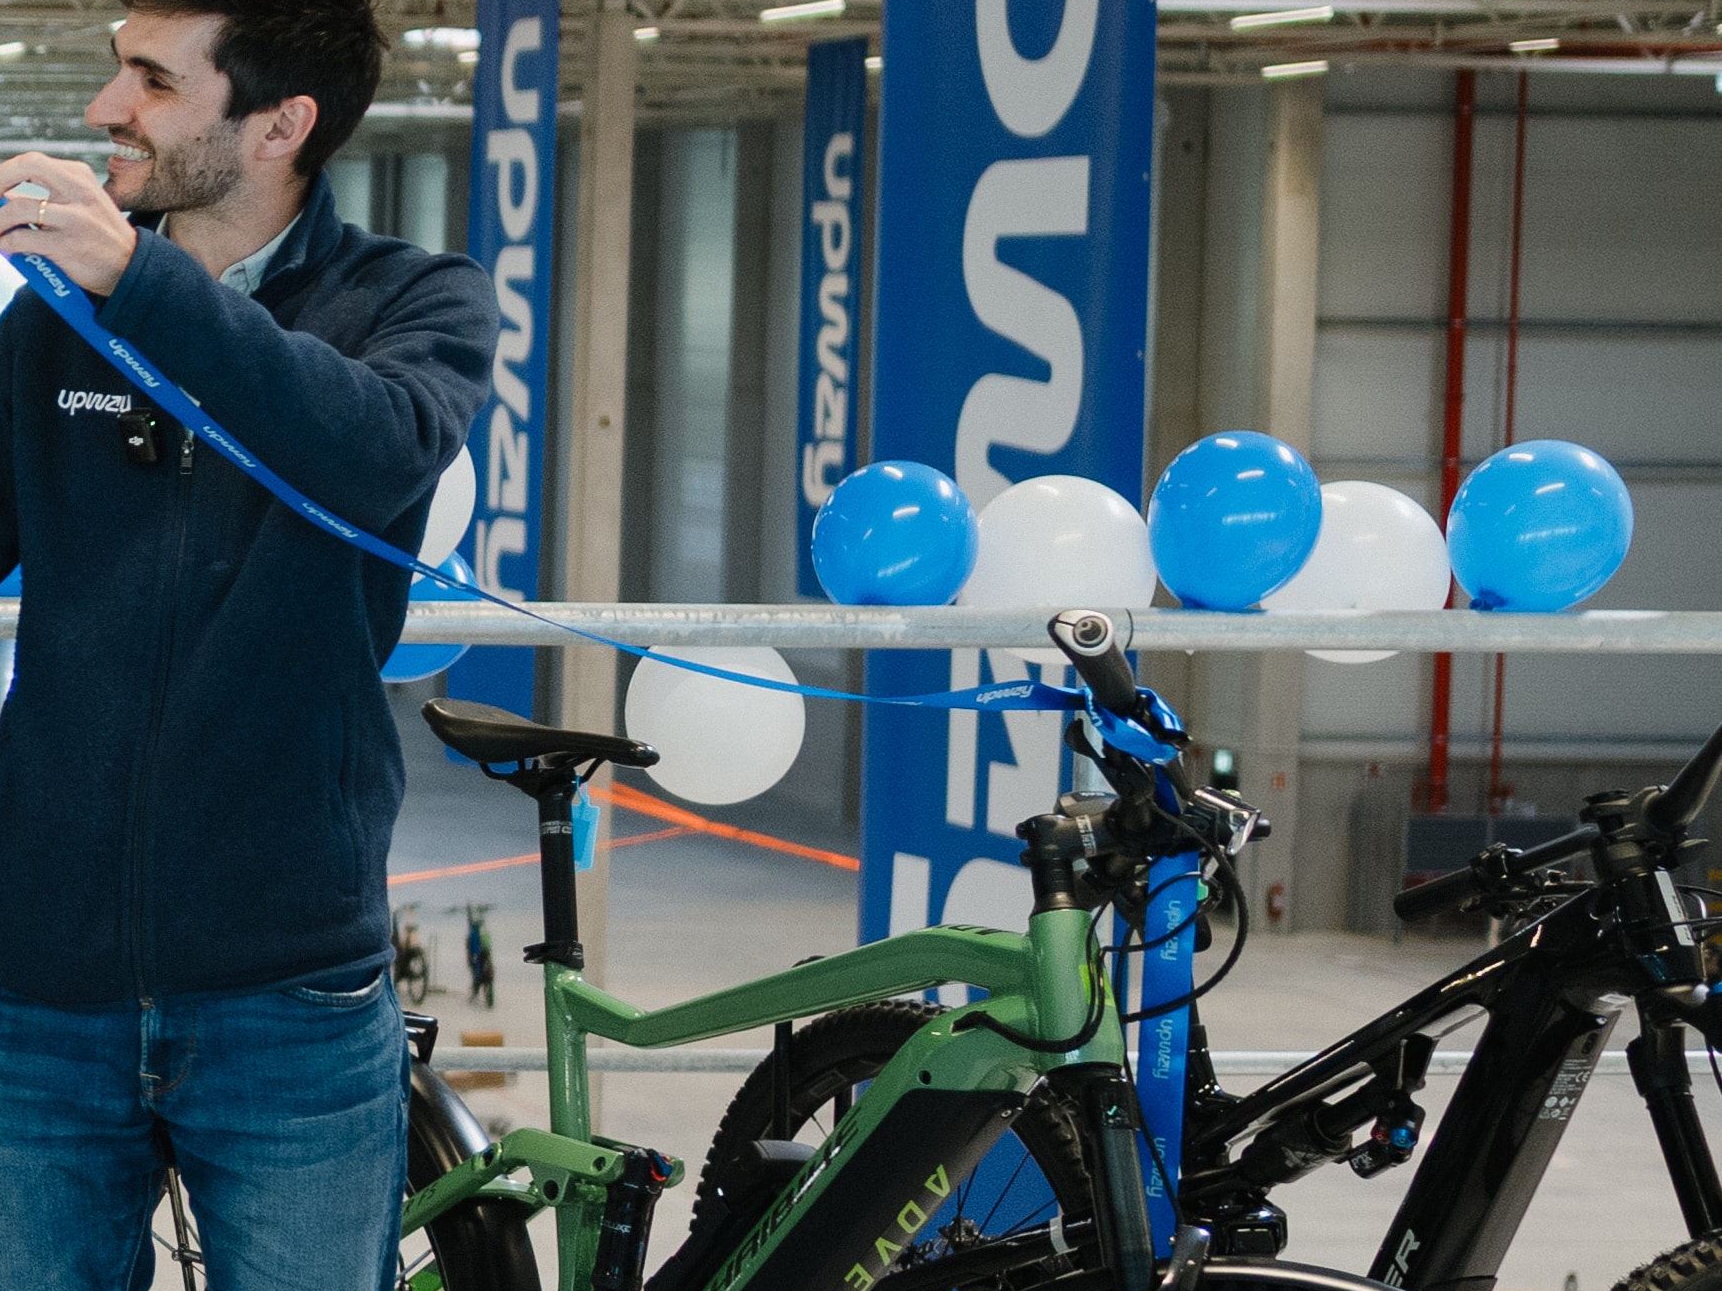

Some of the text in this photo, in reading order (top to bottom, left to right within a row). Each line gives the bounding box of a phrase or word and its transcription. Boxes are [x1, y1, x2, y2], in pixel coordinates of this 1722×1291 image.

[24, 253, 71, 298] pway
[803, 132, 853, 508] upway
[108, 337, 161, 388] upway
[202, 424, 256, 469] upway
[301, 501, 358, 539] upway
[975, 684, 1036, 705] upway
[1152, 1017, 1174, 1080] upway
